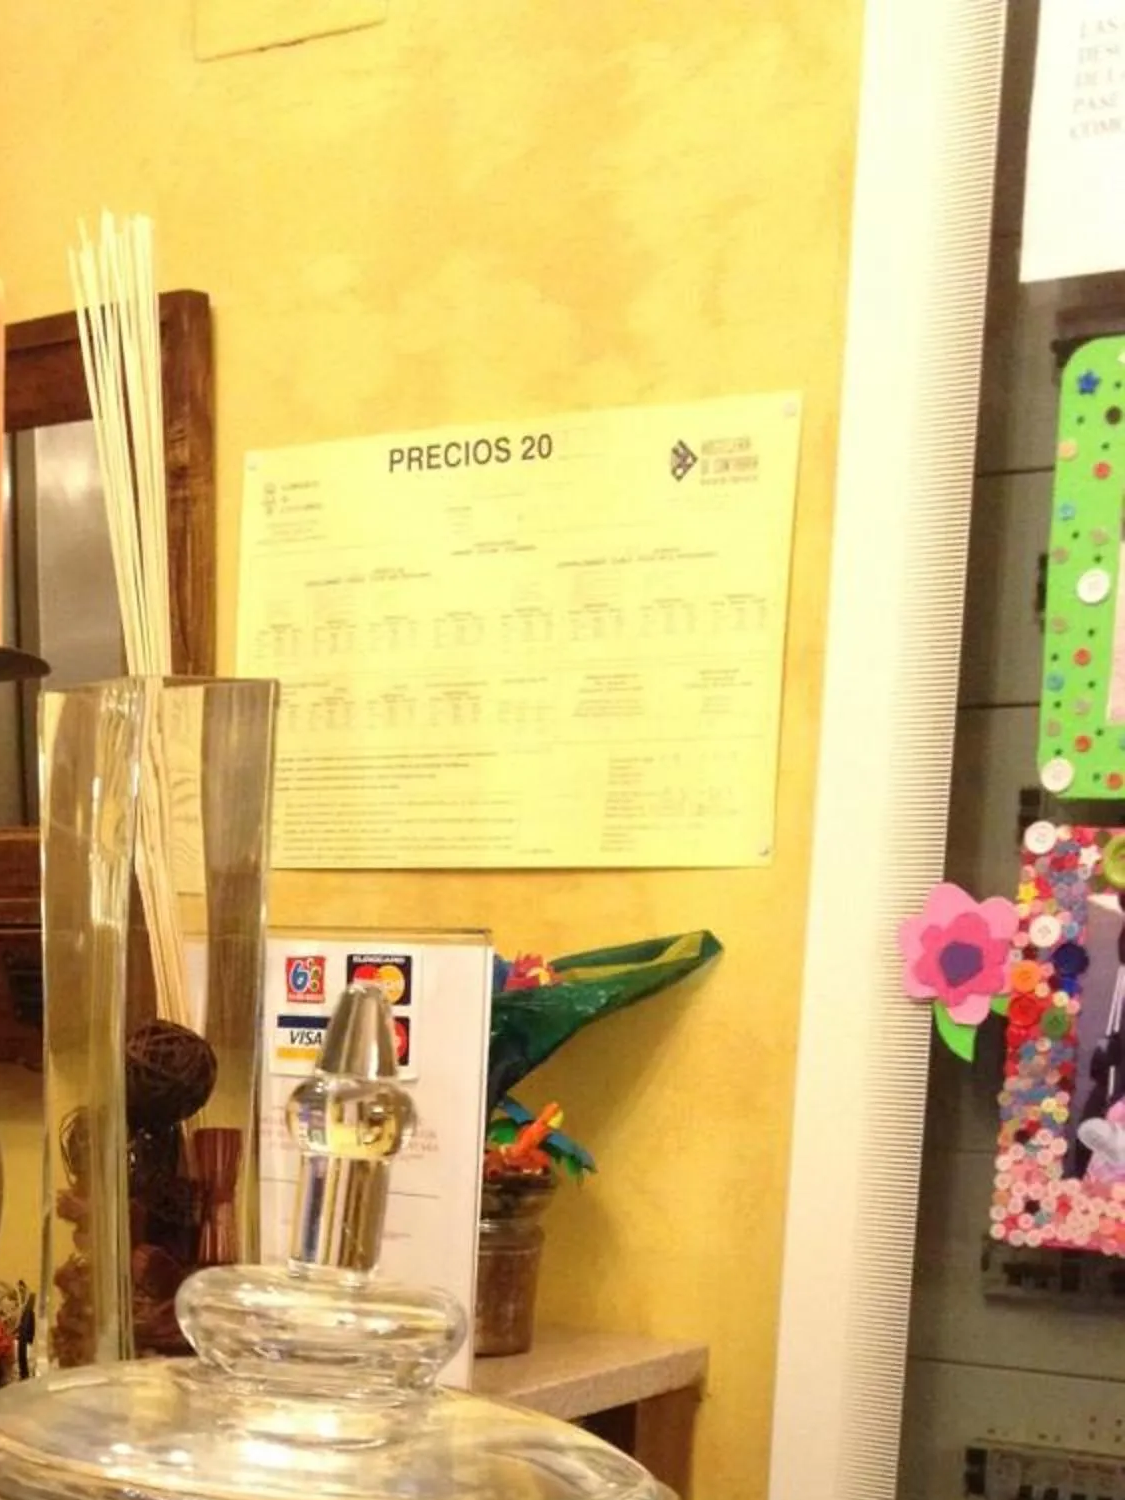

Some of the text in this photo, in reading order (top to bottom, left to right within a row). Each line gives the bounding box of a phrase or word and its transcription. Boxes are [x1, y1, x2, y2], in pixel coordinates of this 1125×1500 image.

[388, 433, 554, 474] PRECIOS 20
[290, 1030, 322, 1045] VISA
